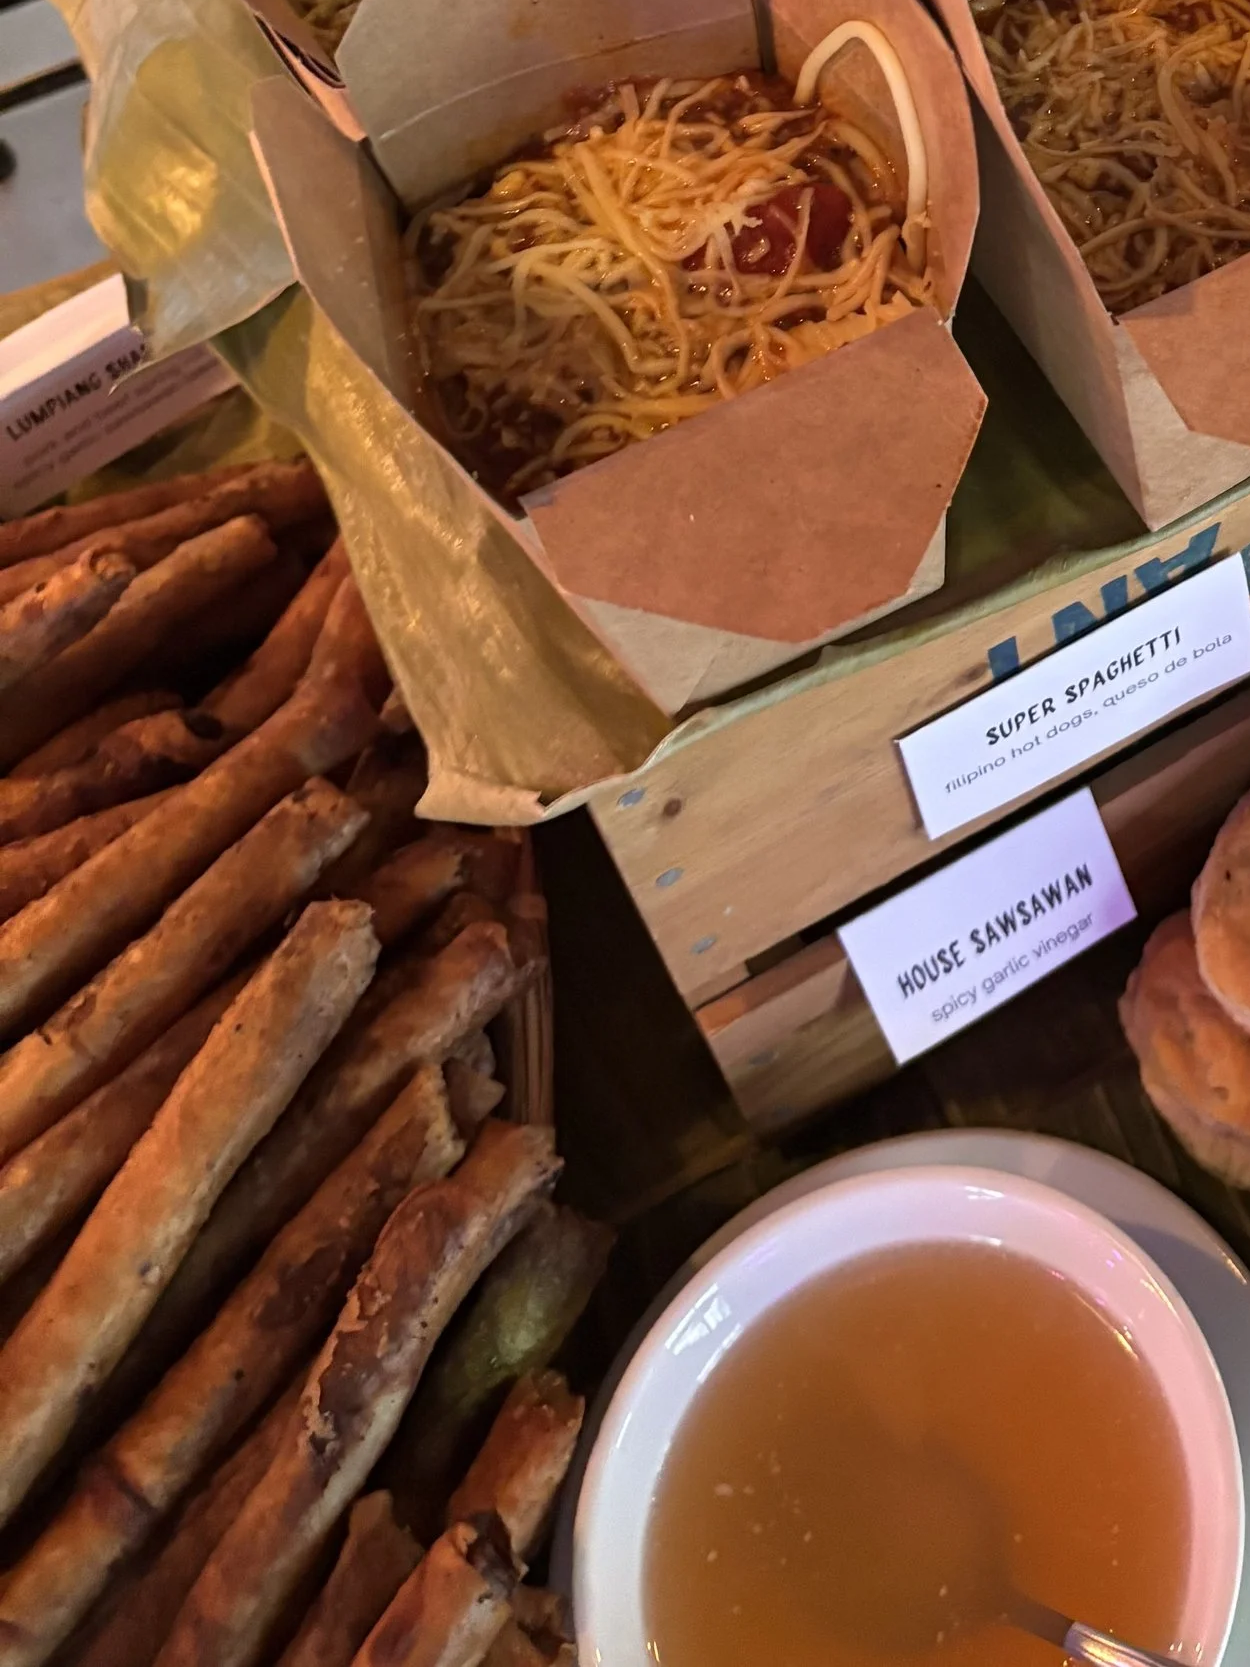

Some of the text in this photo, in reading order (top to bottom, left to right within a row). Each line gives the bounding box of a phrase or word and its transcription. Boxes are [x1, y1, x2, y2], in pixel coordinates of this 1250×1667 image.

[6, 371, 102, 442] LUMPIANG
[105, 343, 146, 380] SHA
[944, 633, 1233, 794] filipino hot dogs, queso de bola
[985, 625, 1181, 746] SUPER SPAGHETTI
[896, 862, 1093, 999] HOUSE SAWSAWAN
[931, 911, 1095, 1023] spicy garlic vinegar
